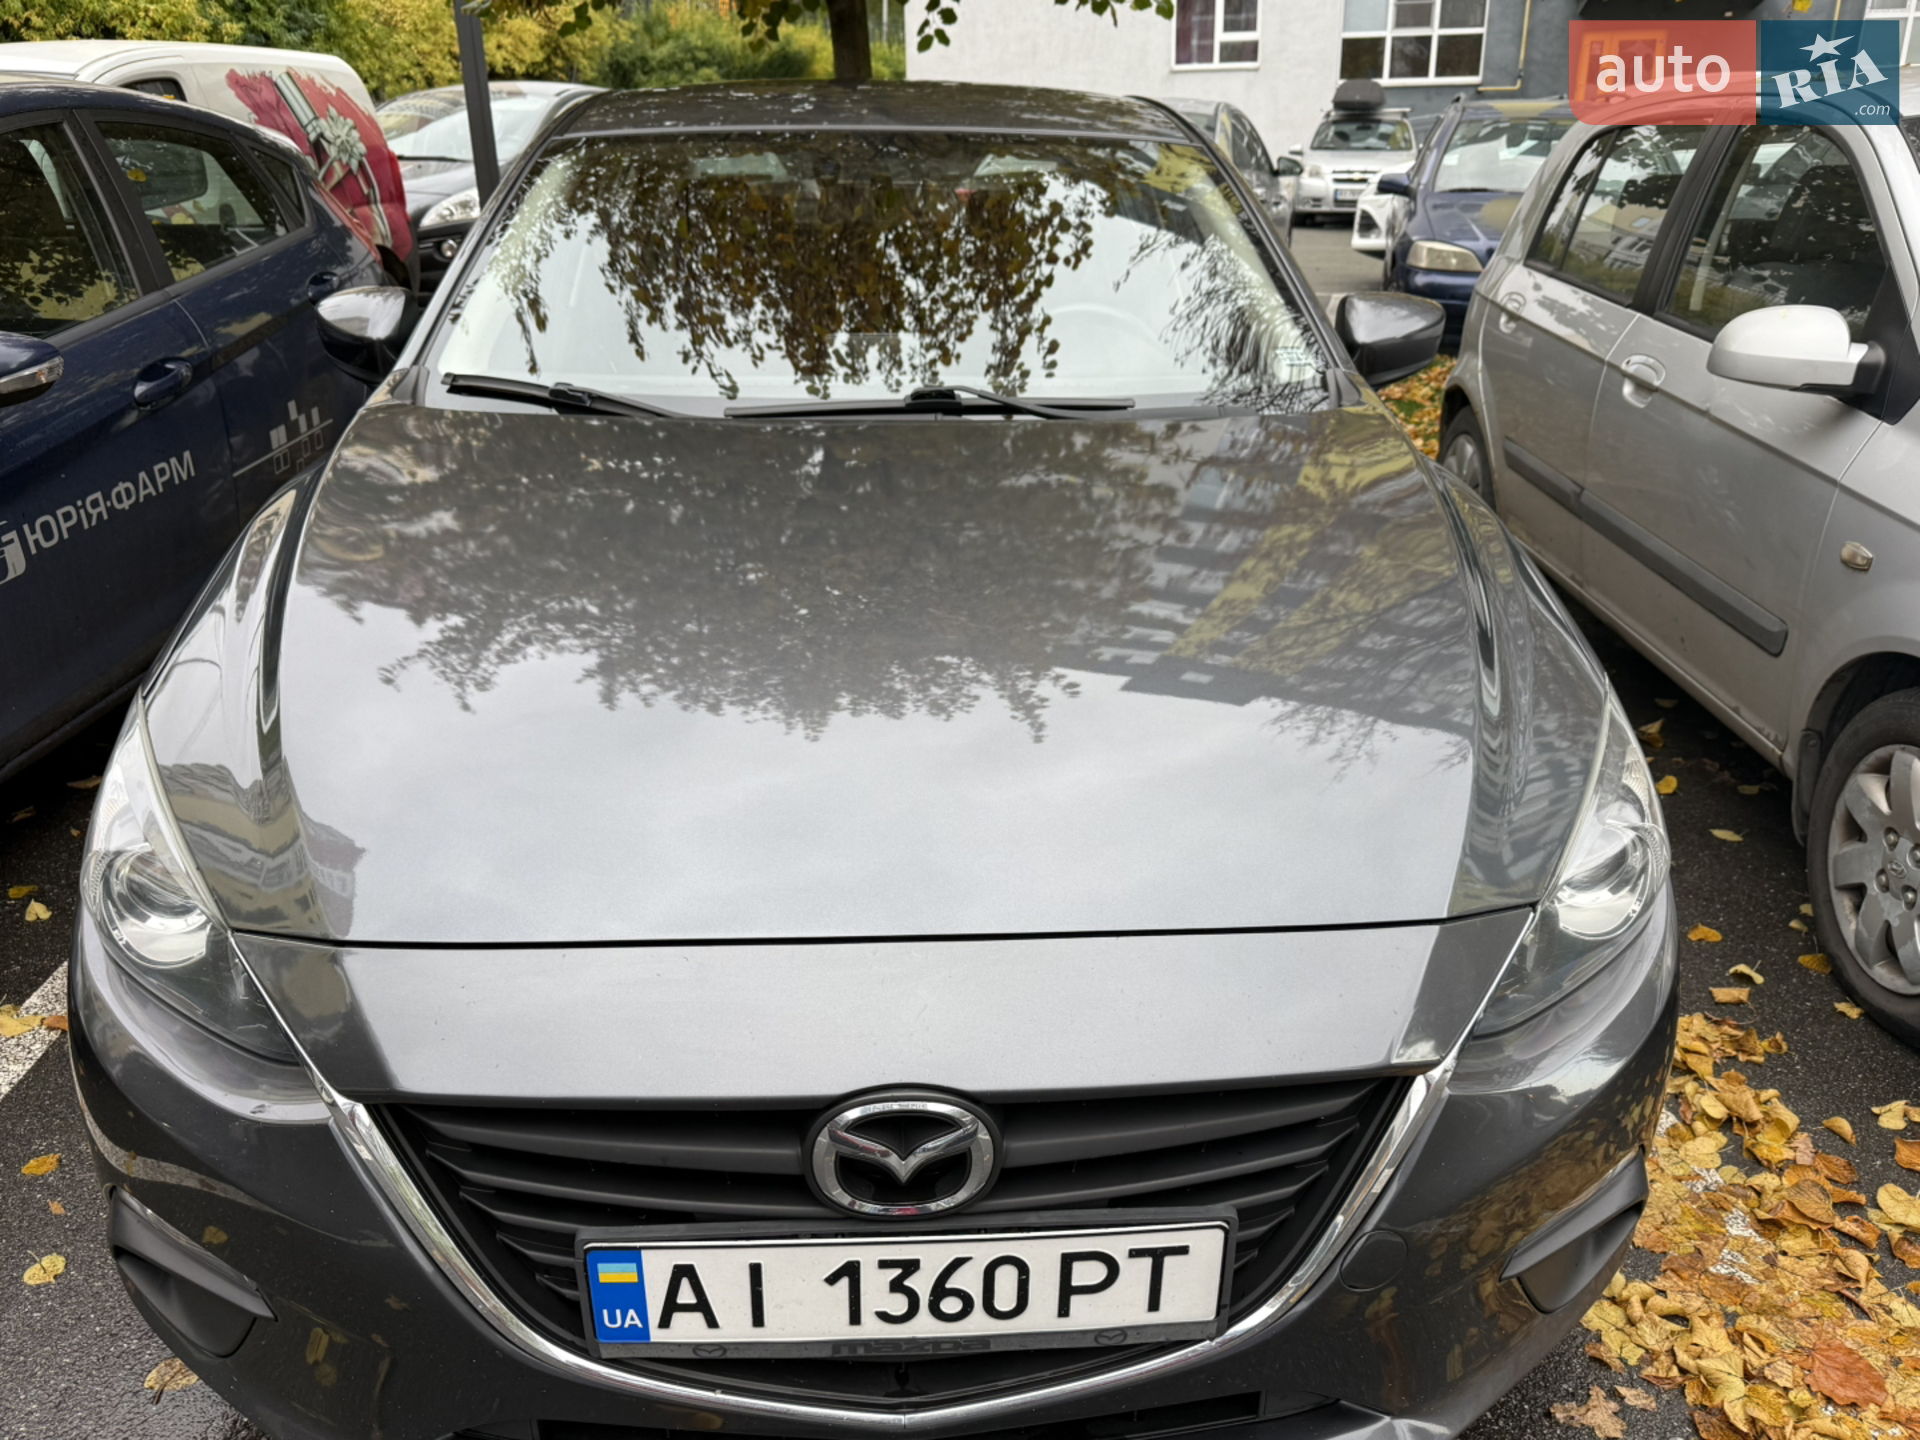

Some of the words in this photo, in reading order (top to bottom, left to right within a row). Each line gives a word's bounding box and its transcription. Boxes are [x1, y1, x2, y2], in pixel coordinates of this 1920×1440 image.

[823, 1254, 1031, 1326] 1360
[1057, 1244, 1190, 1318] PT
[602, 1308, 643, 1329] UA
